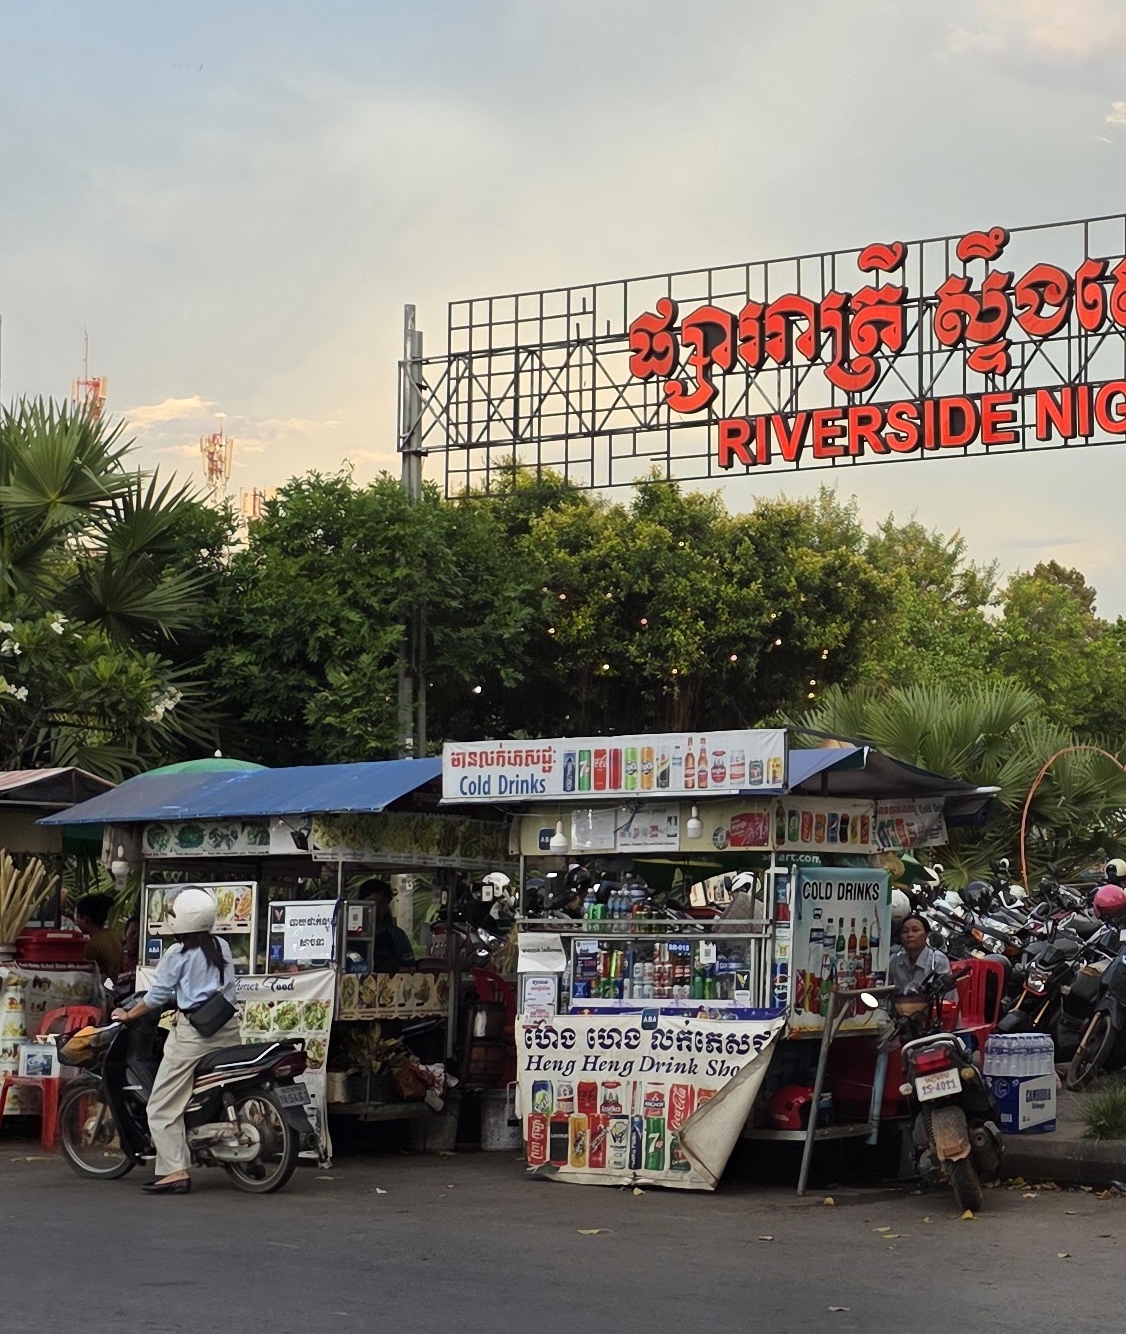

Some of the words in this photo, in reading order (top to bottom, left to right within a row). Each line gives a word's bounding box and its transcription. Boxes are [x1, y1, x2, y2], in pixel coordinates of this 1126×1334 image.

[717, 392, 1020, 469] RIVERSIDE
[460, 774, 491, 796] Cold
[498, 773, 546, 795] Drinks
[802, 881, 833, 901] COLD
[837, 882, 880, 901] DRINKS
[262, 975, 295, 992] Food
[525, 1054, 577, 1077] Heng
[581, 1055, 635, 1077] Heng
[638, 1055, 698, 1076] Drink
